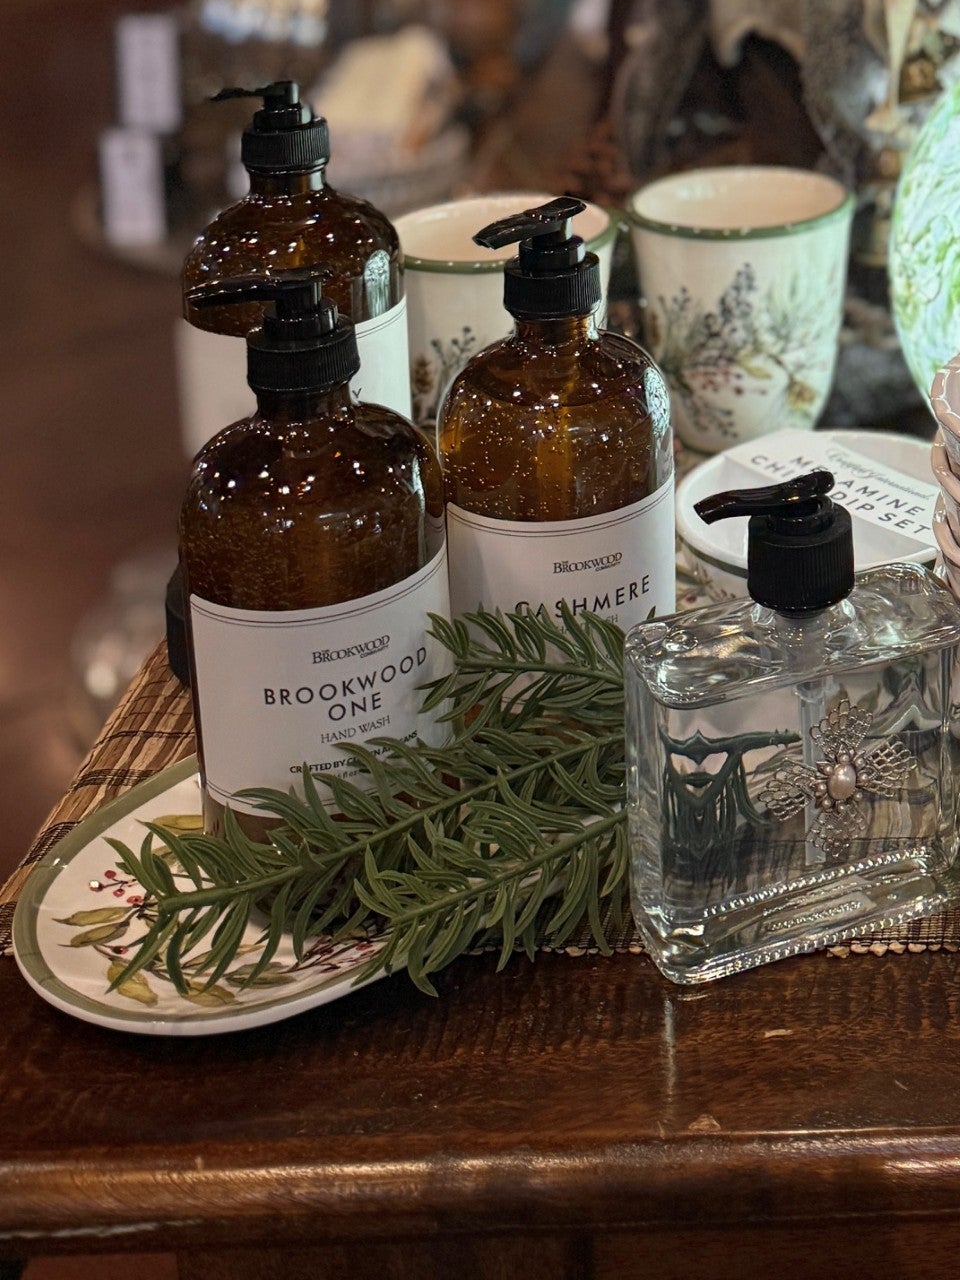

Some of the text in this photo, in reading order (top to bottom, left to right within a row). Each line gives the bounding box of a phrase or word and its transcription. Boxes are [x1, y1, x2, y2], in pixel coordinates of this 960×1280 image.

[789, 456, 926, 516] MEAMINE
[830, 491, 875, 511] DIP
[878, 512, 931, 534] SET
[553, 552, 623, 574] BROOKWOOD
[312, 634, 391, 664] BROOKWOOD
[264, 646, 427, 705] BROOKWOOD
[328, 692, 383, 721] ONE
[320, 714, 391, 744] HAND WASH
[290, 762, 332, 773] CRFTED
[333, 759, 346, 768] BY
